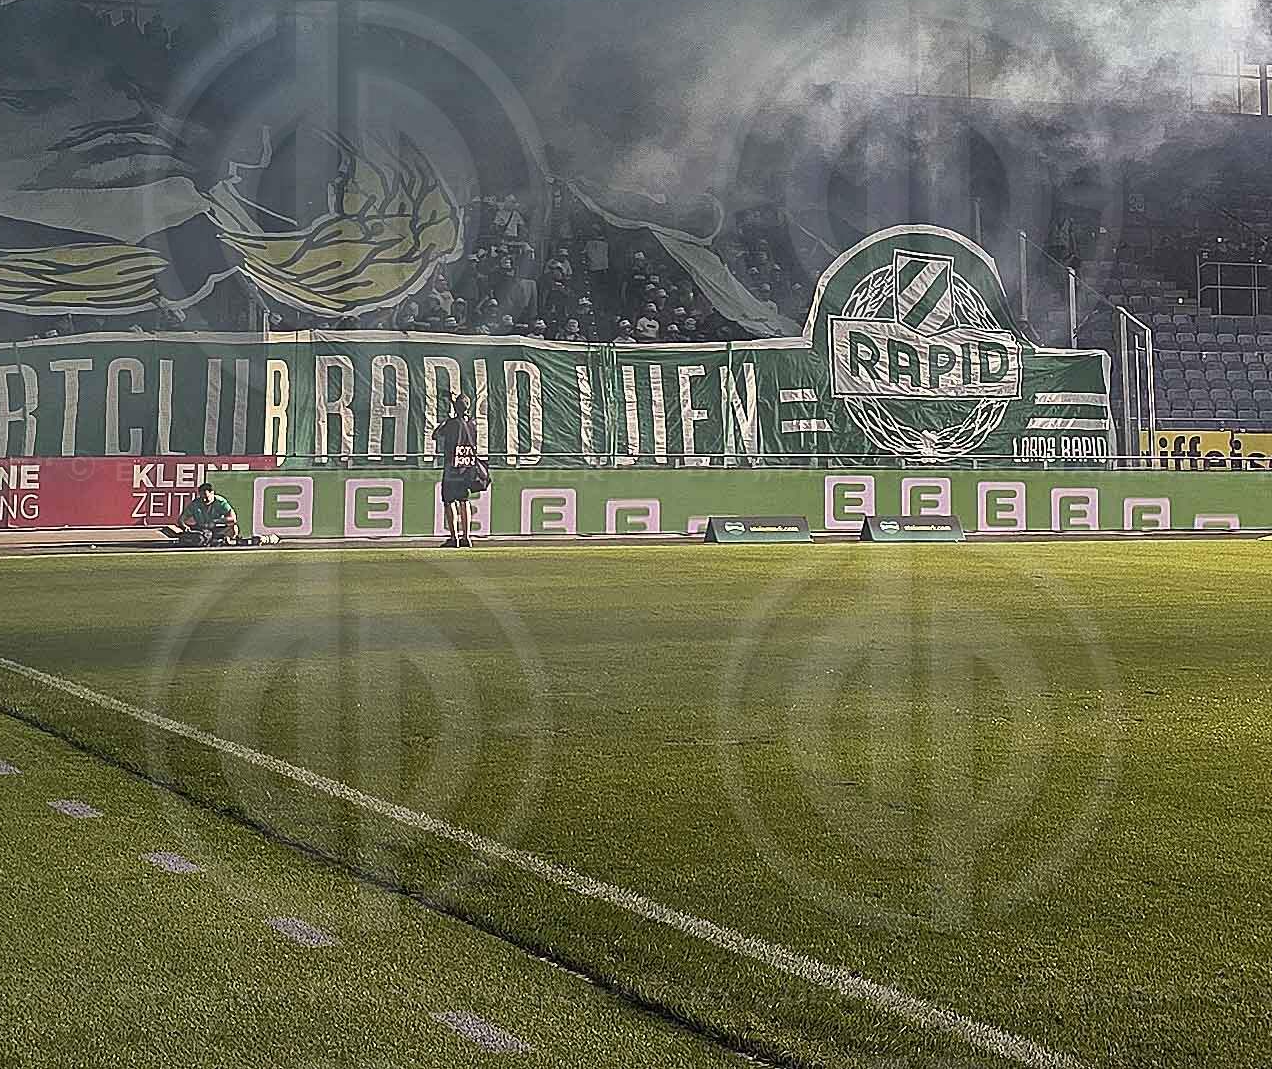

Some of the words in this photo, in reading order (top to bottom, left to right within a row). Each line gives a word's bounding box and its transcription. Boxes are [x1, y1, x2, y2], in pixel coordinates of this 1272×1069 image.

[848, 330, 1011, 390] RAPID
[314, 355, 543, 466] RAPID
[1012, 436, 1056, 463] LORDS
[1060, 436, 1107, 463] RAPID
